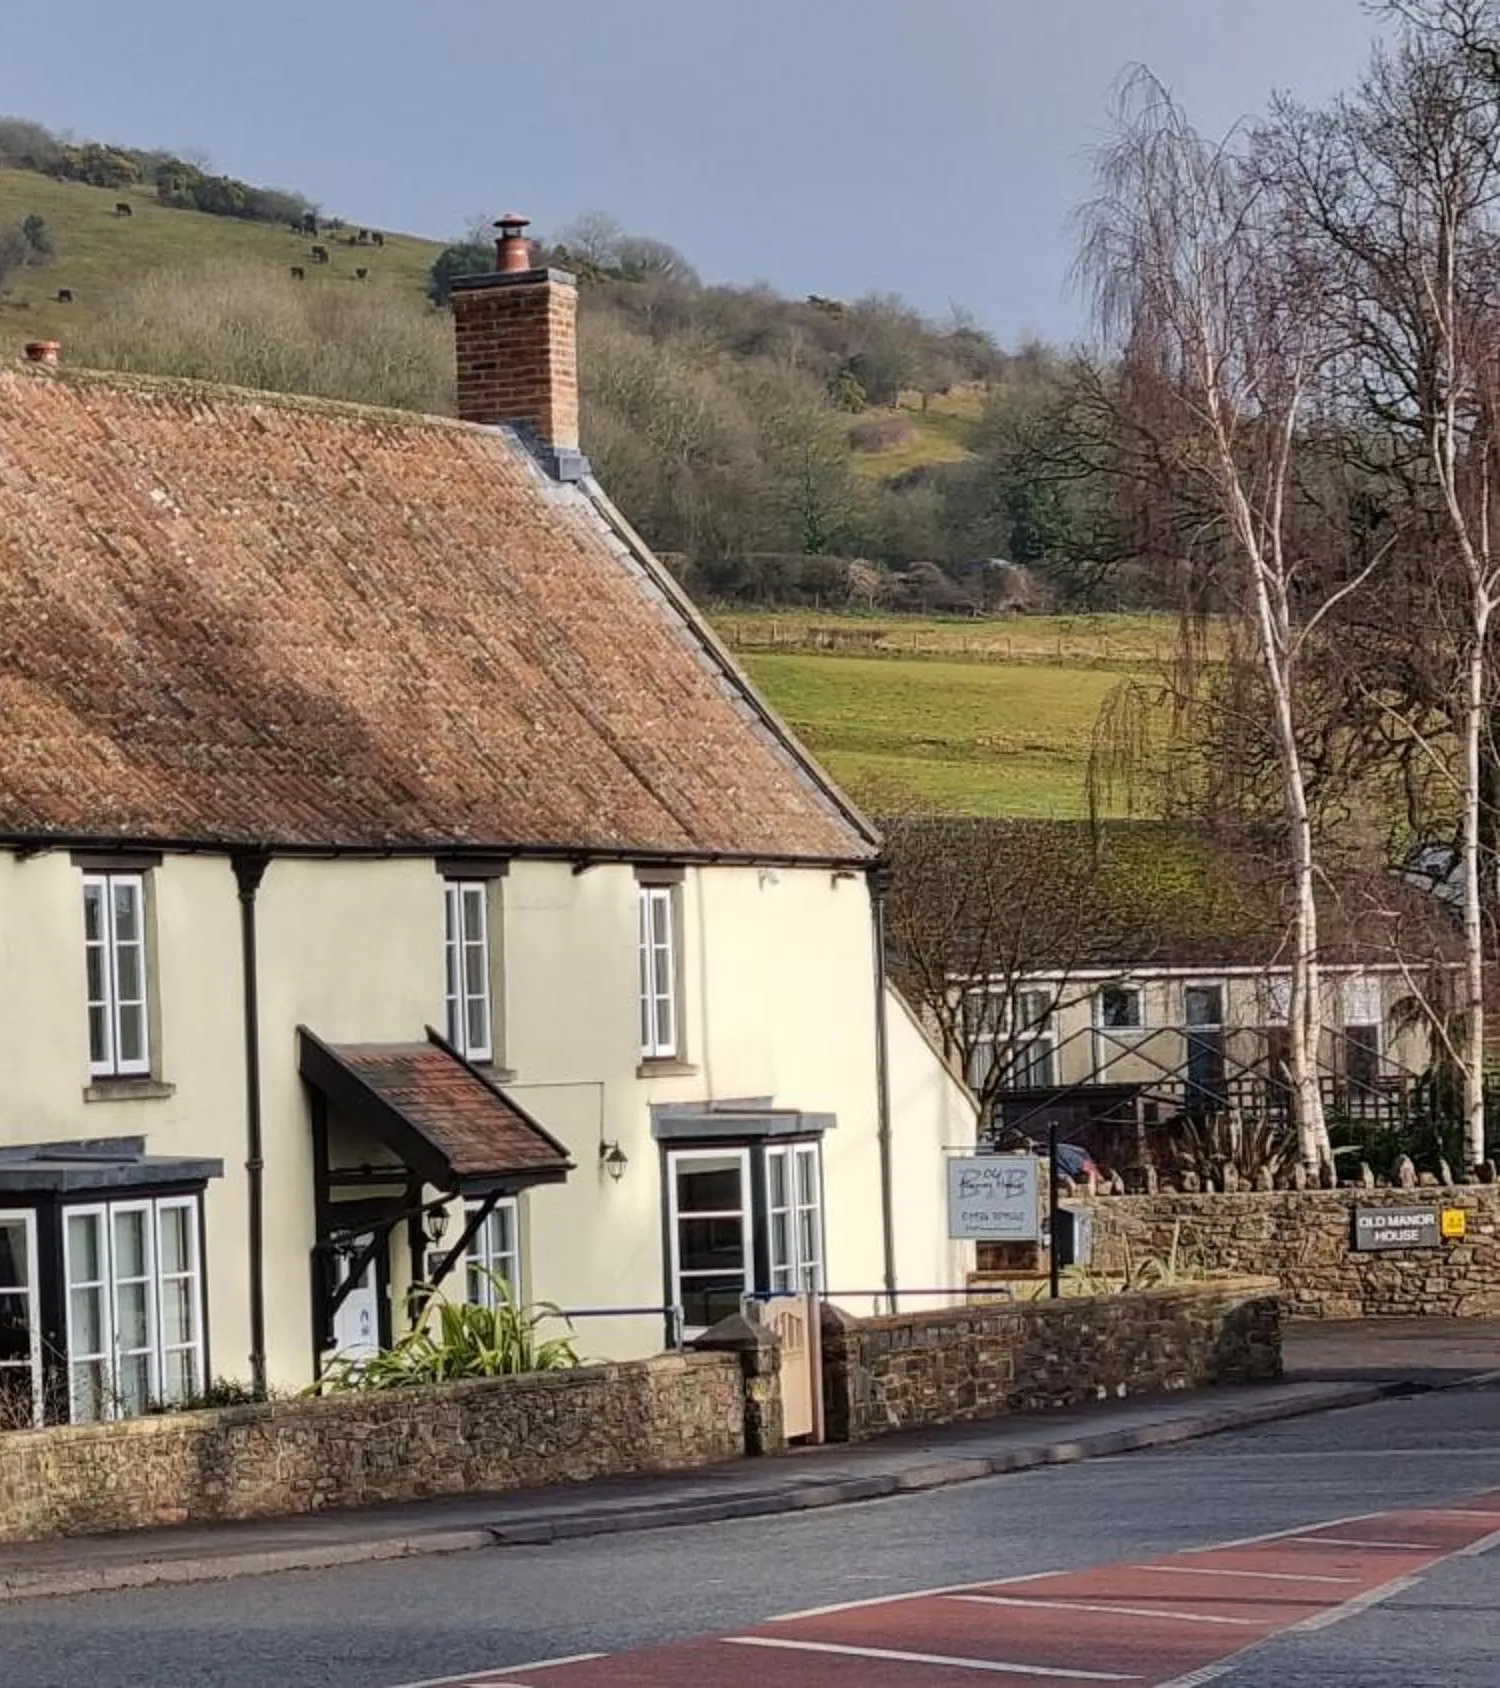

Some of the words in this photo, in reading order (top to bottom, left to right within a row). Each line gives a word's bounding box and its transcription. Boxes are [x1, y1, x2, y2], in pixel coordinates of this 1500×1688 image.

[1359, 1216, 1385, 1228] OLD
[1387, 1214, 1435, 1227] MANOR
[1374, 1230, 1419, 1242] HOUSE
